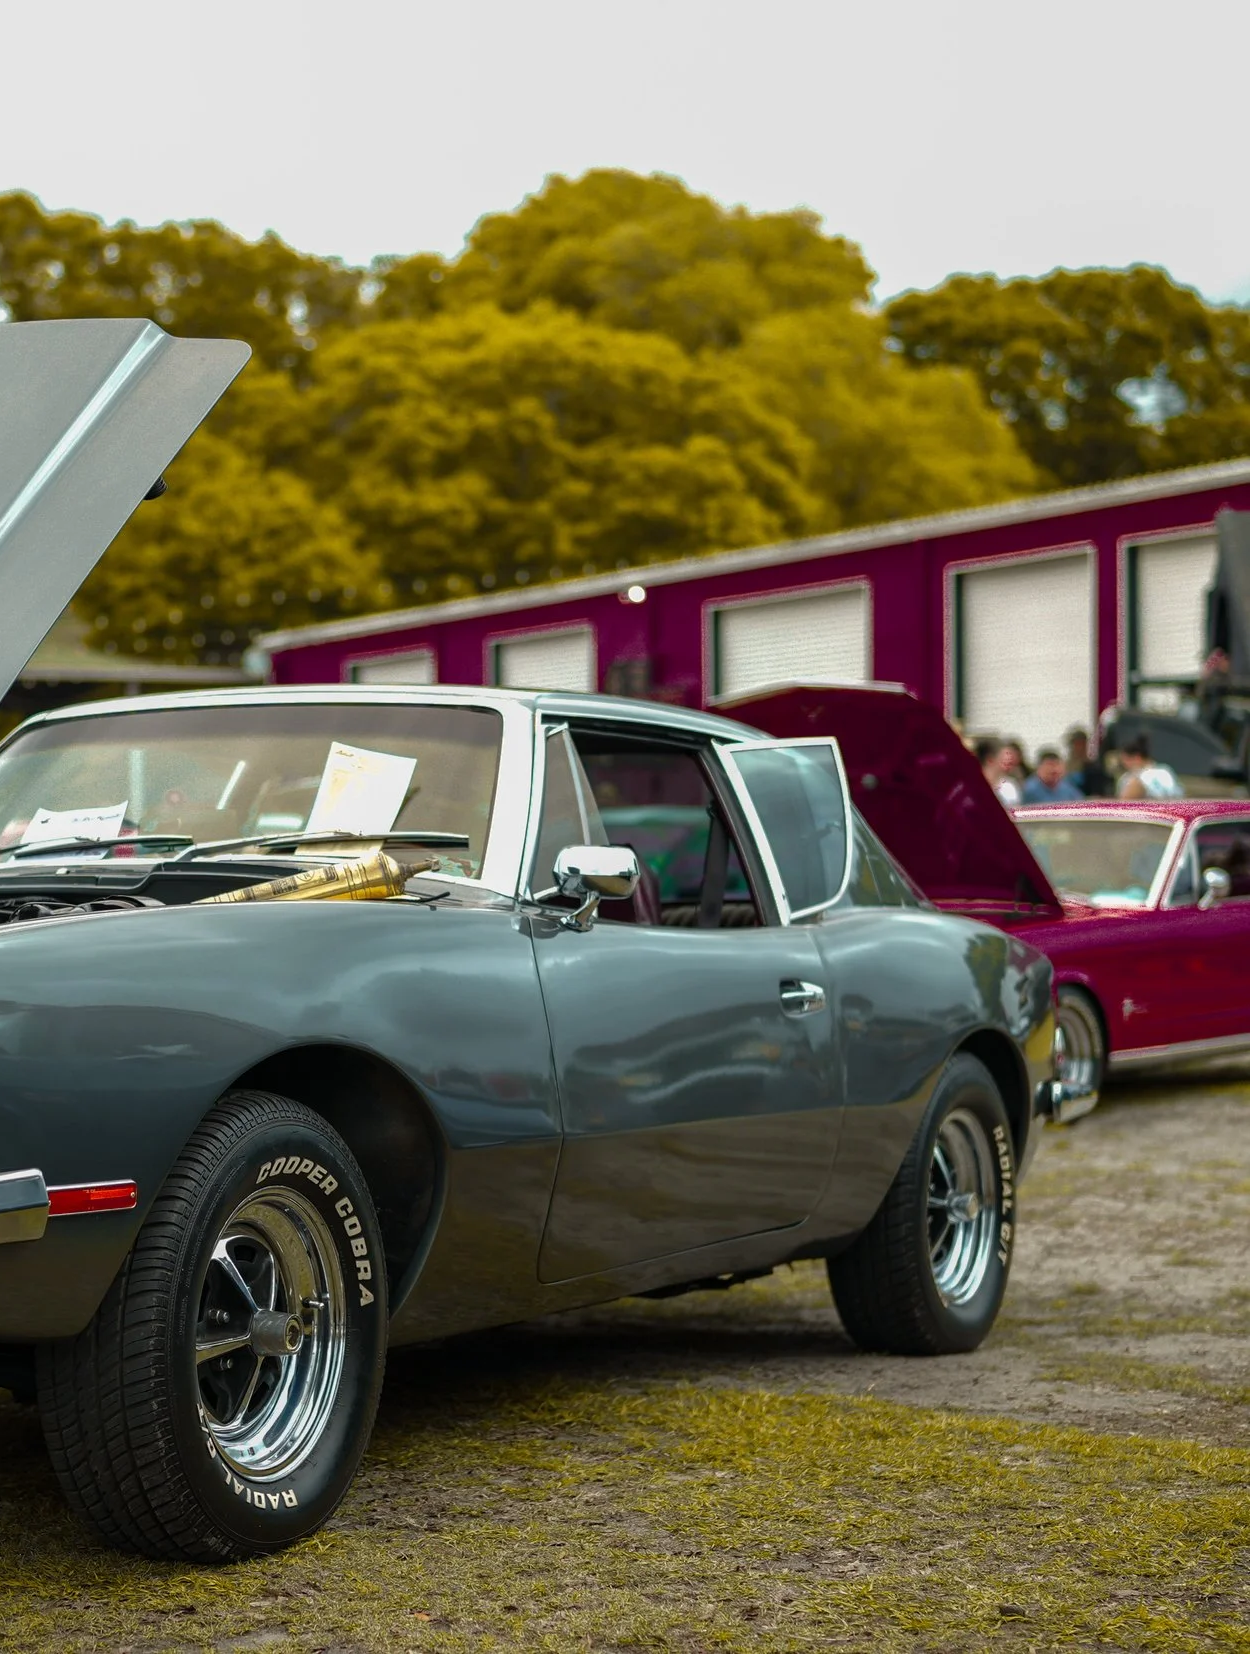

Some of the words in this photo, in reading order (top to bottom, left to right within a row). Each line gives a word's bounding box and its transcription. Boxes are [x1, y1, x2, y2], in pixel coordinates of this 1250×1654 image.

[993, 1125, 1012, 1214] RADIAL
[256, 1156, 339, 1195] COOPER
[335, 1197, 374, 1306] COBRA
[222, 1463, 299, 1510] RADIAL
